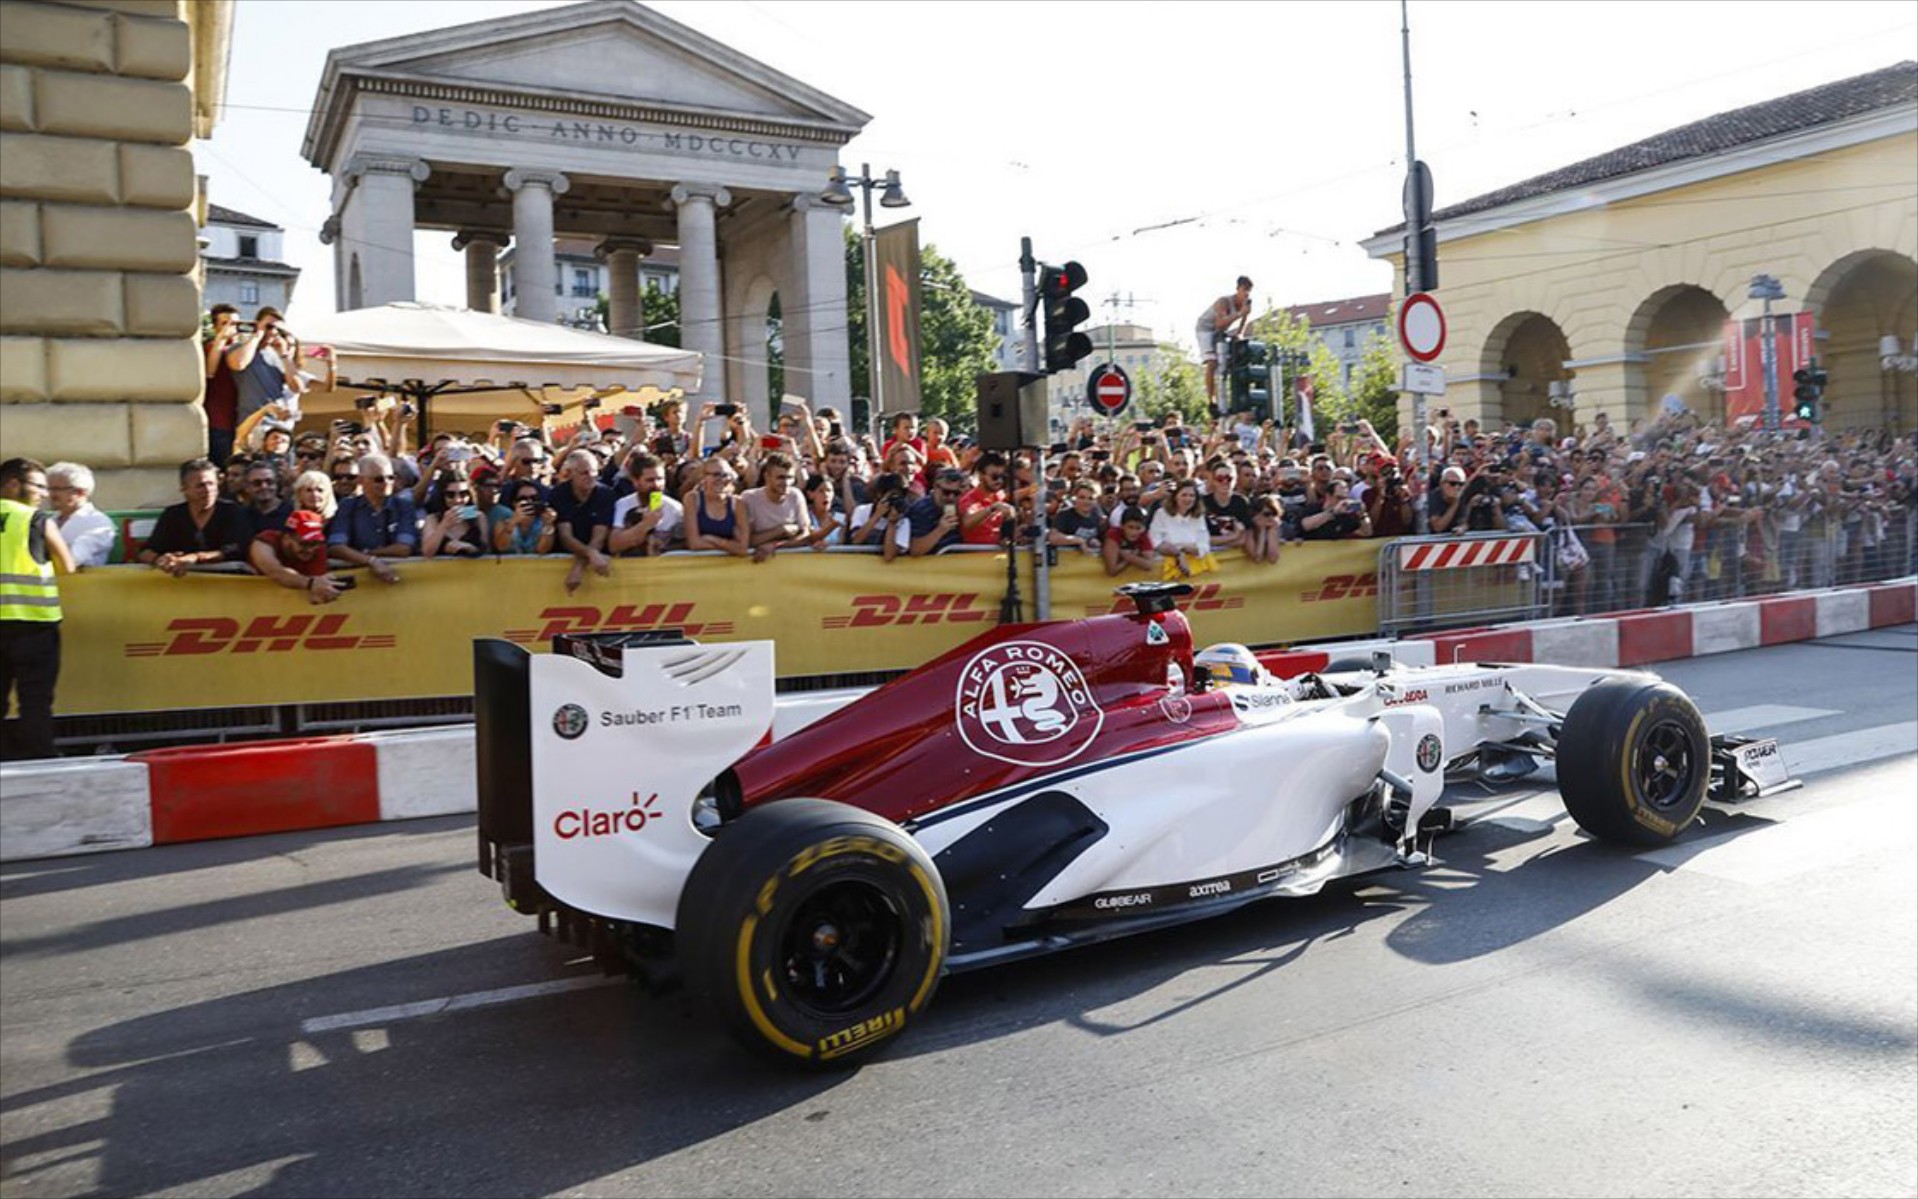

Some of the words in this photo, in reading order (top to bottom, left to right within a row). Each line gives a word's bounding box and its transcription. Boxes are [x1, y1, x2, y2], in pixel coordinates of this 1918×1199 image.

[411, 106, 520, 133] DEDIC
[550, 121, 638, 146] ANNO
[664, 132, 801, 162] MDCCCXV
[538, 603, 704, 642] DHL
[852, 593, 985, 627] DHL
[163, 614, 361, 656] DHL
[963, 658, 998, 718] ALFA
[1006, 646, 1086, 705] ROMEO
[600, 710, 666, 727] Sauber
[670, 706, 692, 721] F1
[697, 703, 742, 719] Team
[554, 805, 647, 840] Claro
[1094, 893, 1152, 910] GLOBEAIR
[818, 1006, 907, 1054] PIRELLI
